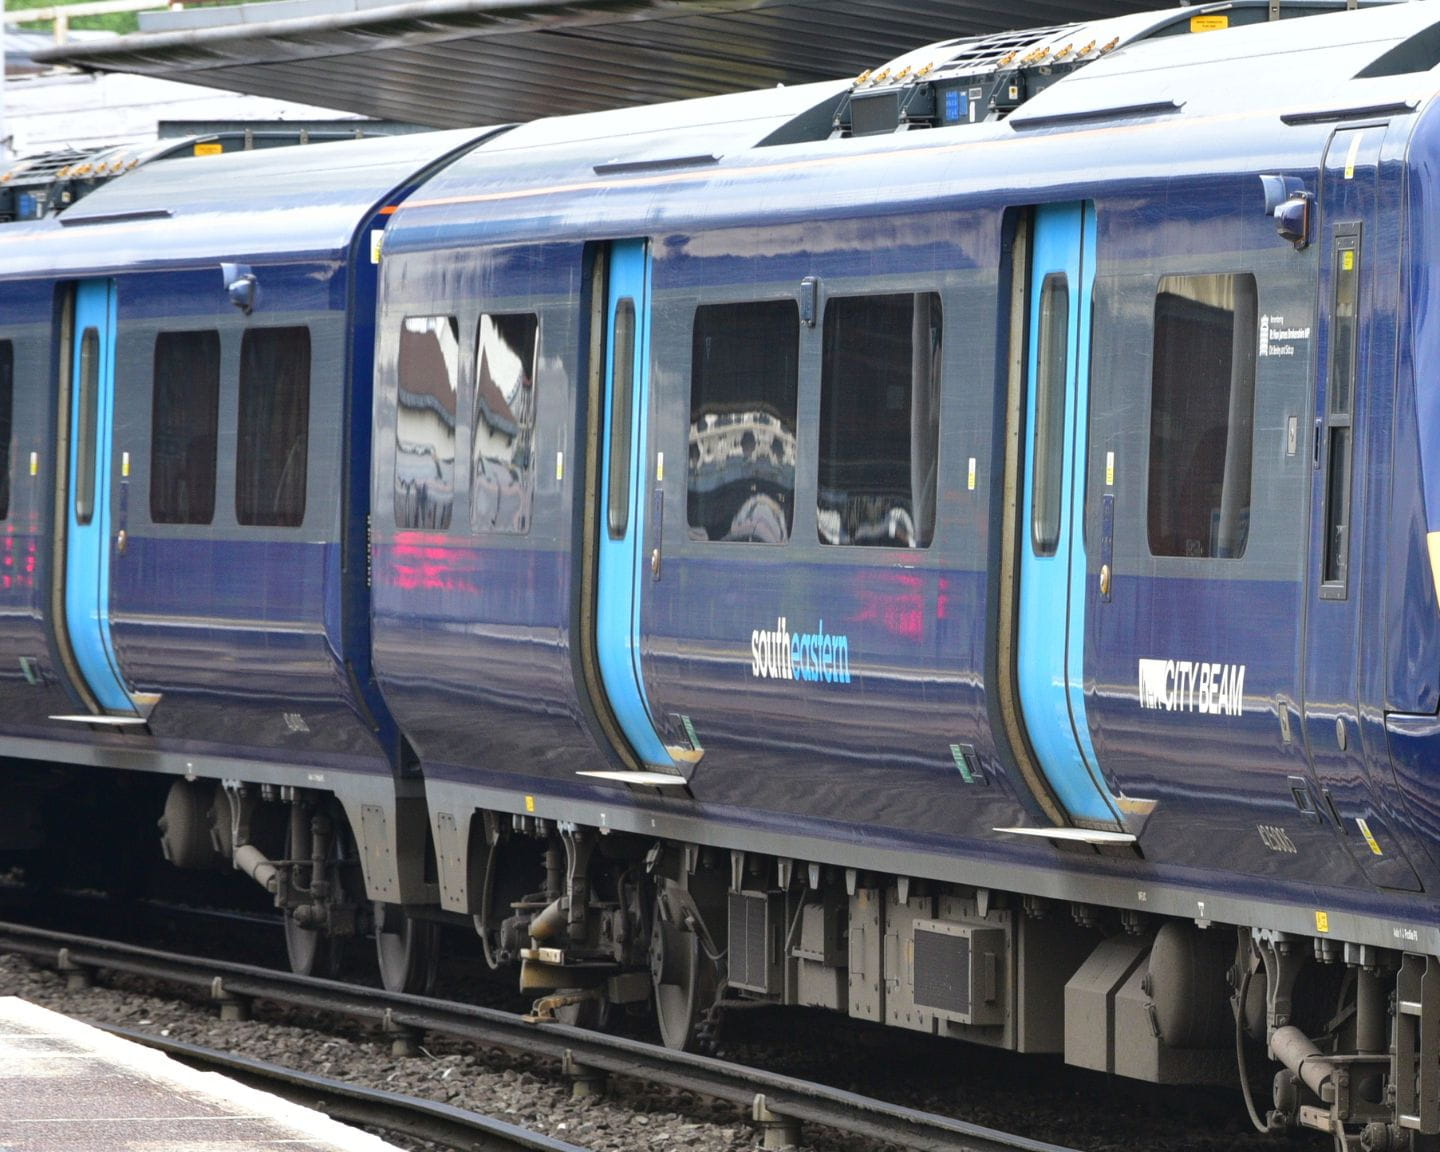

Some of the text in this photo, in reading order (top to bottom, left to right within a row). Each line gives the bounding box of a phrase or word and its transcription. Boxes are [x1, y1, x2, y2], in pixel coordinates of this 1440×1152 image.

[751, 616, 851, 684] southeastern
[1165, 659, 1245, 717] CITY BEAM
